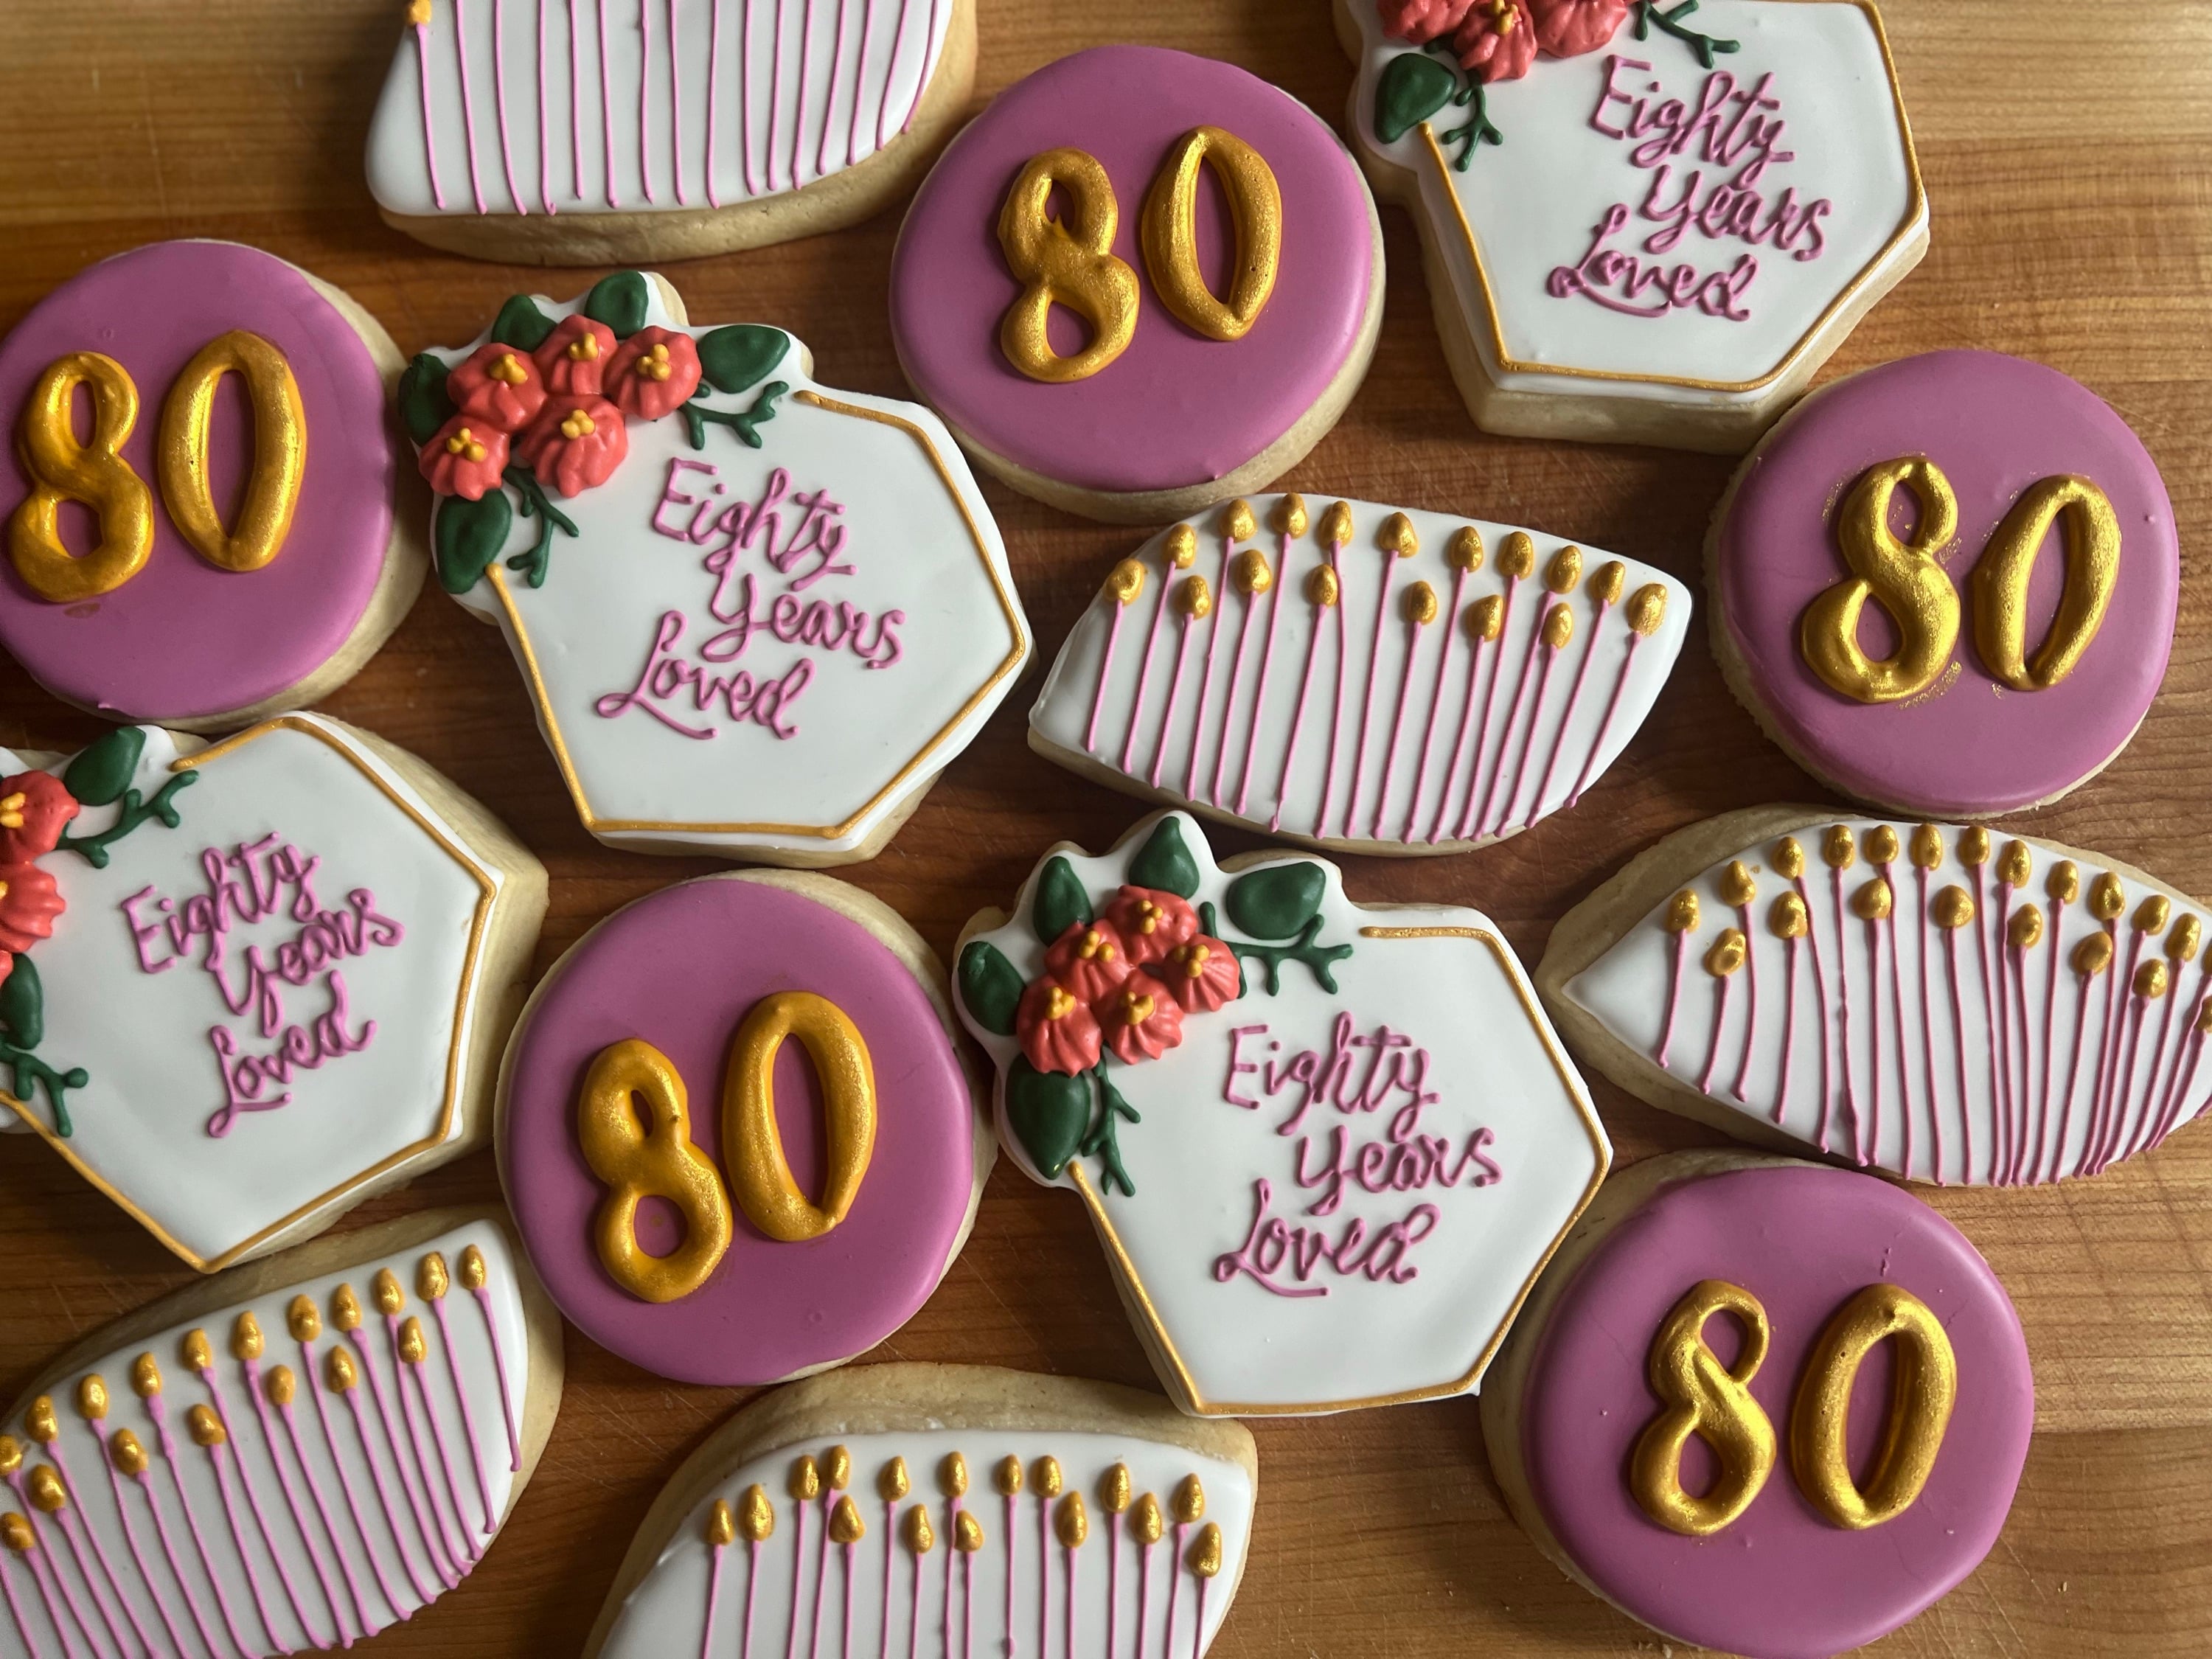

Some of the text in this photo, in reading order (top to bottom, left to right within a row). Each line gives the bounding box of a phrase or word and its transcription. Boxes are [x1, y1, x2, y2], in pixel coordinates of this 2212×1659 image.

[1589, 54, 1796, 189] Eighty
[998, 125, 1281, 383] 80
[1547, 203, 1759, 321] Loved
[8, 329, 307, 603] 80
[653, 456, 858, 591] Eighty
[1800, 455, 2122, 704] 80
[597, 610, 815, 740] Loved
[120, 830, 321, 974] Eighty
[207, 969, 378, 1138] Loved
[1222, 1011, 1441, 1144] Eighty
[577, 990, 877, 1304] 80
[1214, 1178, 1441, 1298] Loved
[1630, 1279, 1958, 1537] 80
